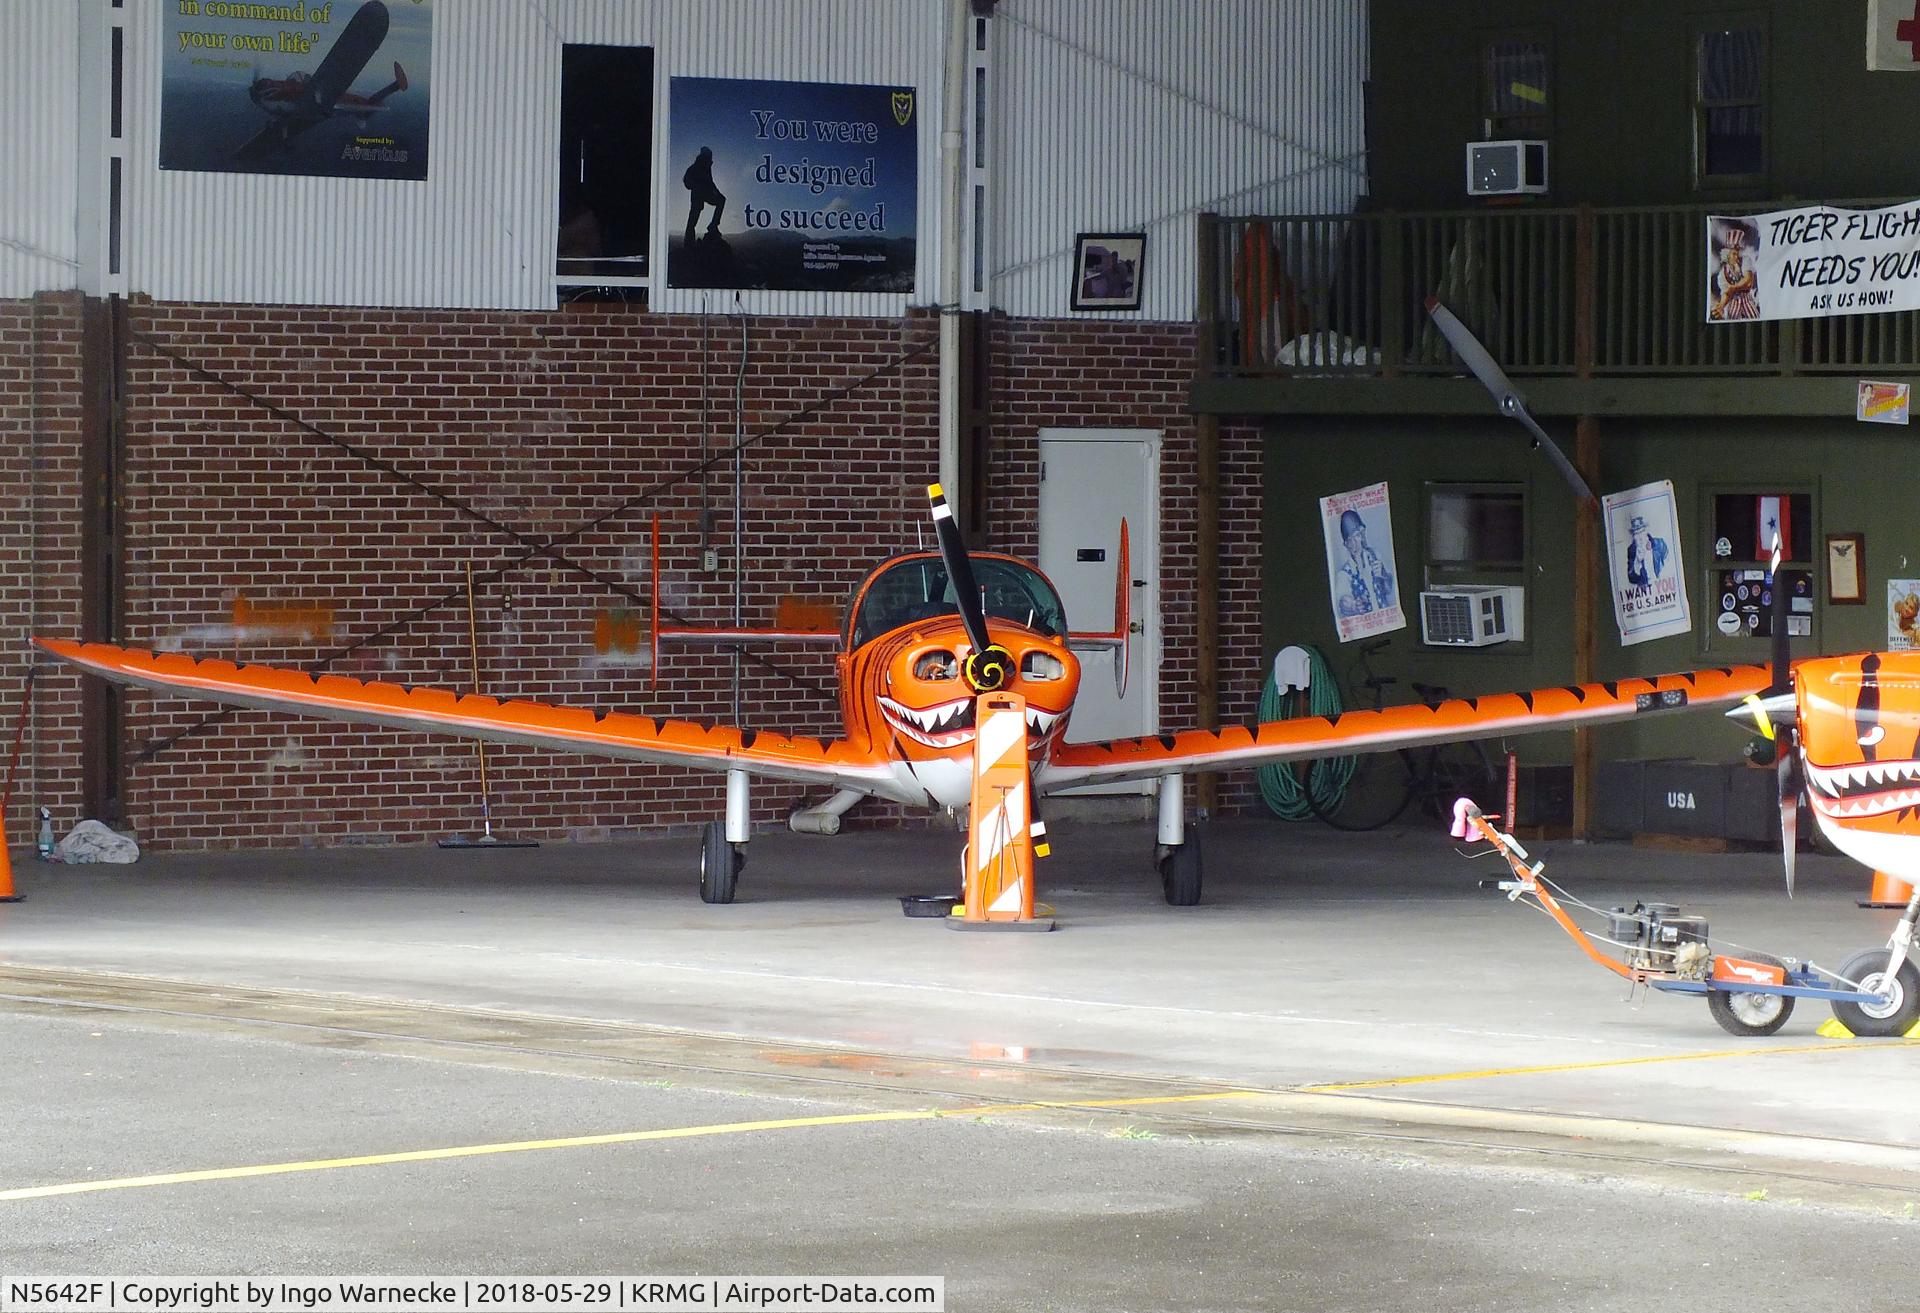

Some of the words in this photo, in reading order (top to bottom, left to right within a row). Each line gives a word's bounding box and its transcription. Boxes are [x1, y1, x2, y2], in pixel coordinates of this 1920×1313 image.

[179, 0, 200, 15] in
[205, 0, 305, 22] command
[310, 3, 332, 23] of
[178, 31, 227, 52] your
[232, 34, 274, 51] own
[279, 31, 320, 54] life"
[751, 109, 808, 141] You
[814, 119, 879, 144] were
[755, 153, 876, 195] designed
[744, 203, 772, 230] to
[779, 201, 886, 233] succeed
[1771, 212, 1838, 246] TIGER
[1841, 207, 1920, 241] FLIGH
[1780, 254, 1867, 288] NEEDS
[1870, 250, 1920, 281] YOU!
[1810, 294, 1832, 310] ASK
[1837, 292, 1853, 308] US
[1858, 289, 1894, 306] HOW!
[1619, 591, 1624, 603] I
[1625, 583, 1653, 600] WANT
[1654, 576, 1676, 593] YOU
[1622, 603, 1635, 613] FOR
[1655, 592, 1677, 606] ARMY
[1667, 791, 1696, 809] USA
